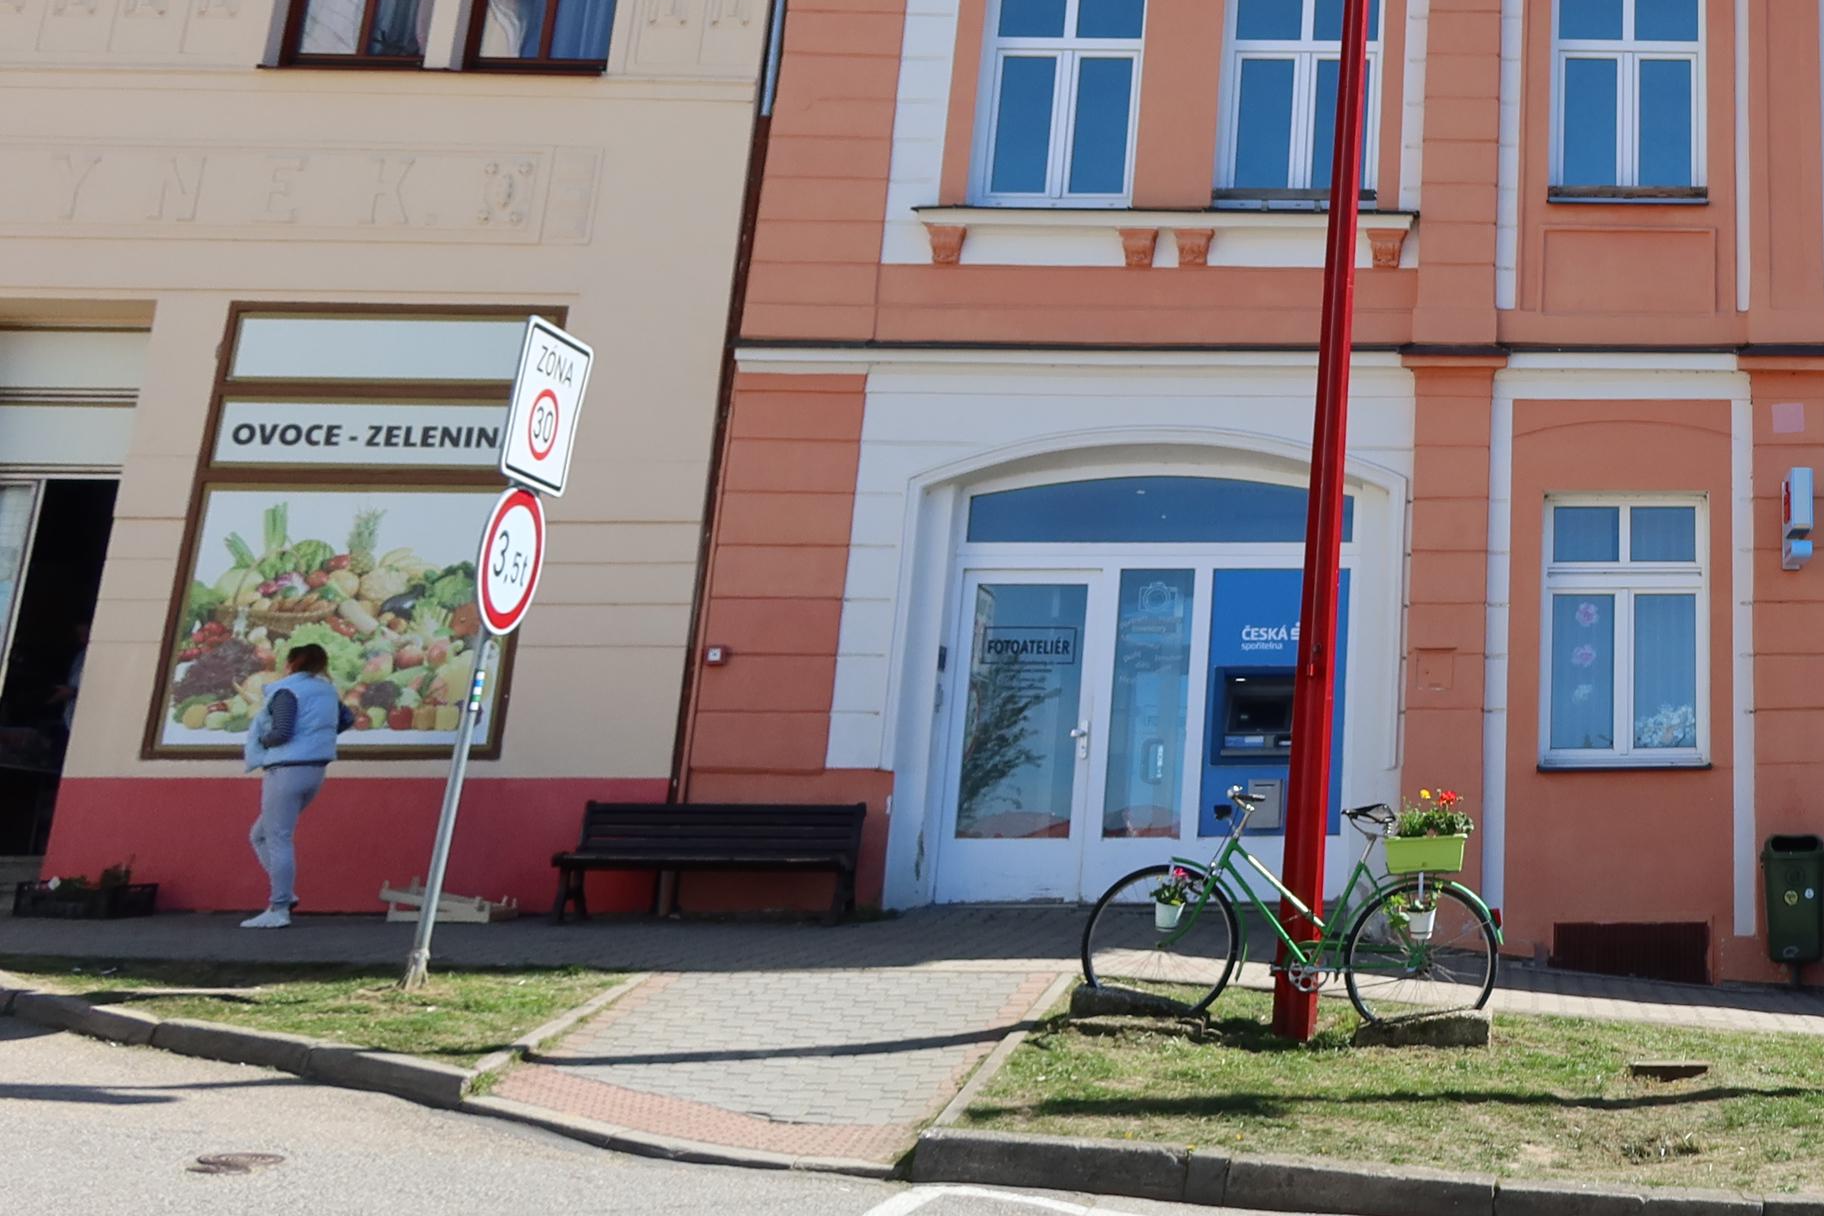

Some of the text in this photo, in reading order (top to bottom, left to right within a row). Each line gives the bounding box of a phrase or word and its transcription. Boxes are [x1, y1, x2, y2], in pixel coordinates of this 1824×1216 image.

[536, 343, 574, 388] ZÓNA
[231, 423, 501, 449] OVOCE - ZELENIN
[532, 406, 554, 444] 30
[493, 529, 528, 588] 3,5t
[1241, 624, 1288, 641] ČESKÁ
[986, 637, 1071, 655] FOTOATELIÉR
[1241, 642, 1283, 651] spořitelna
